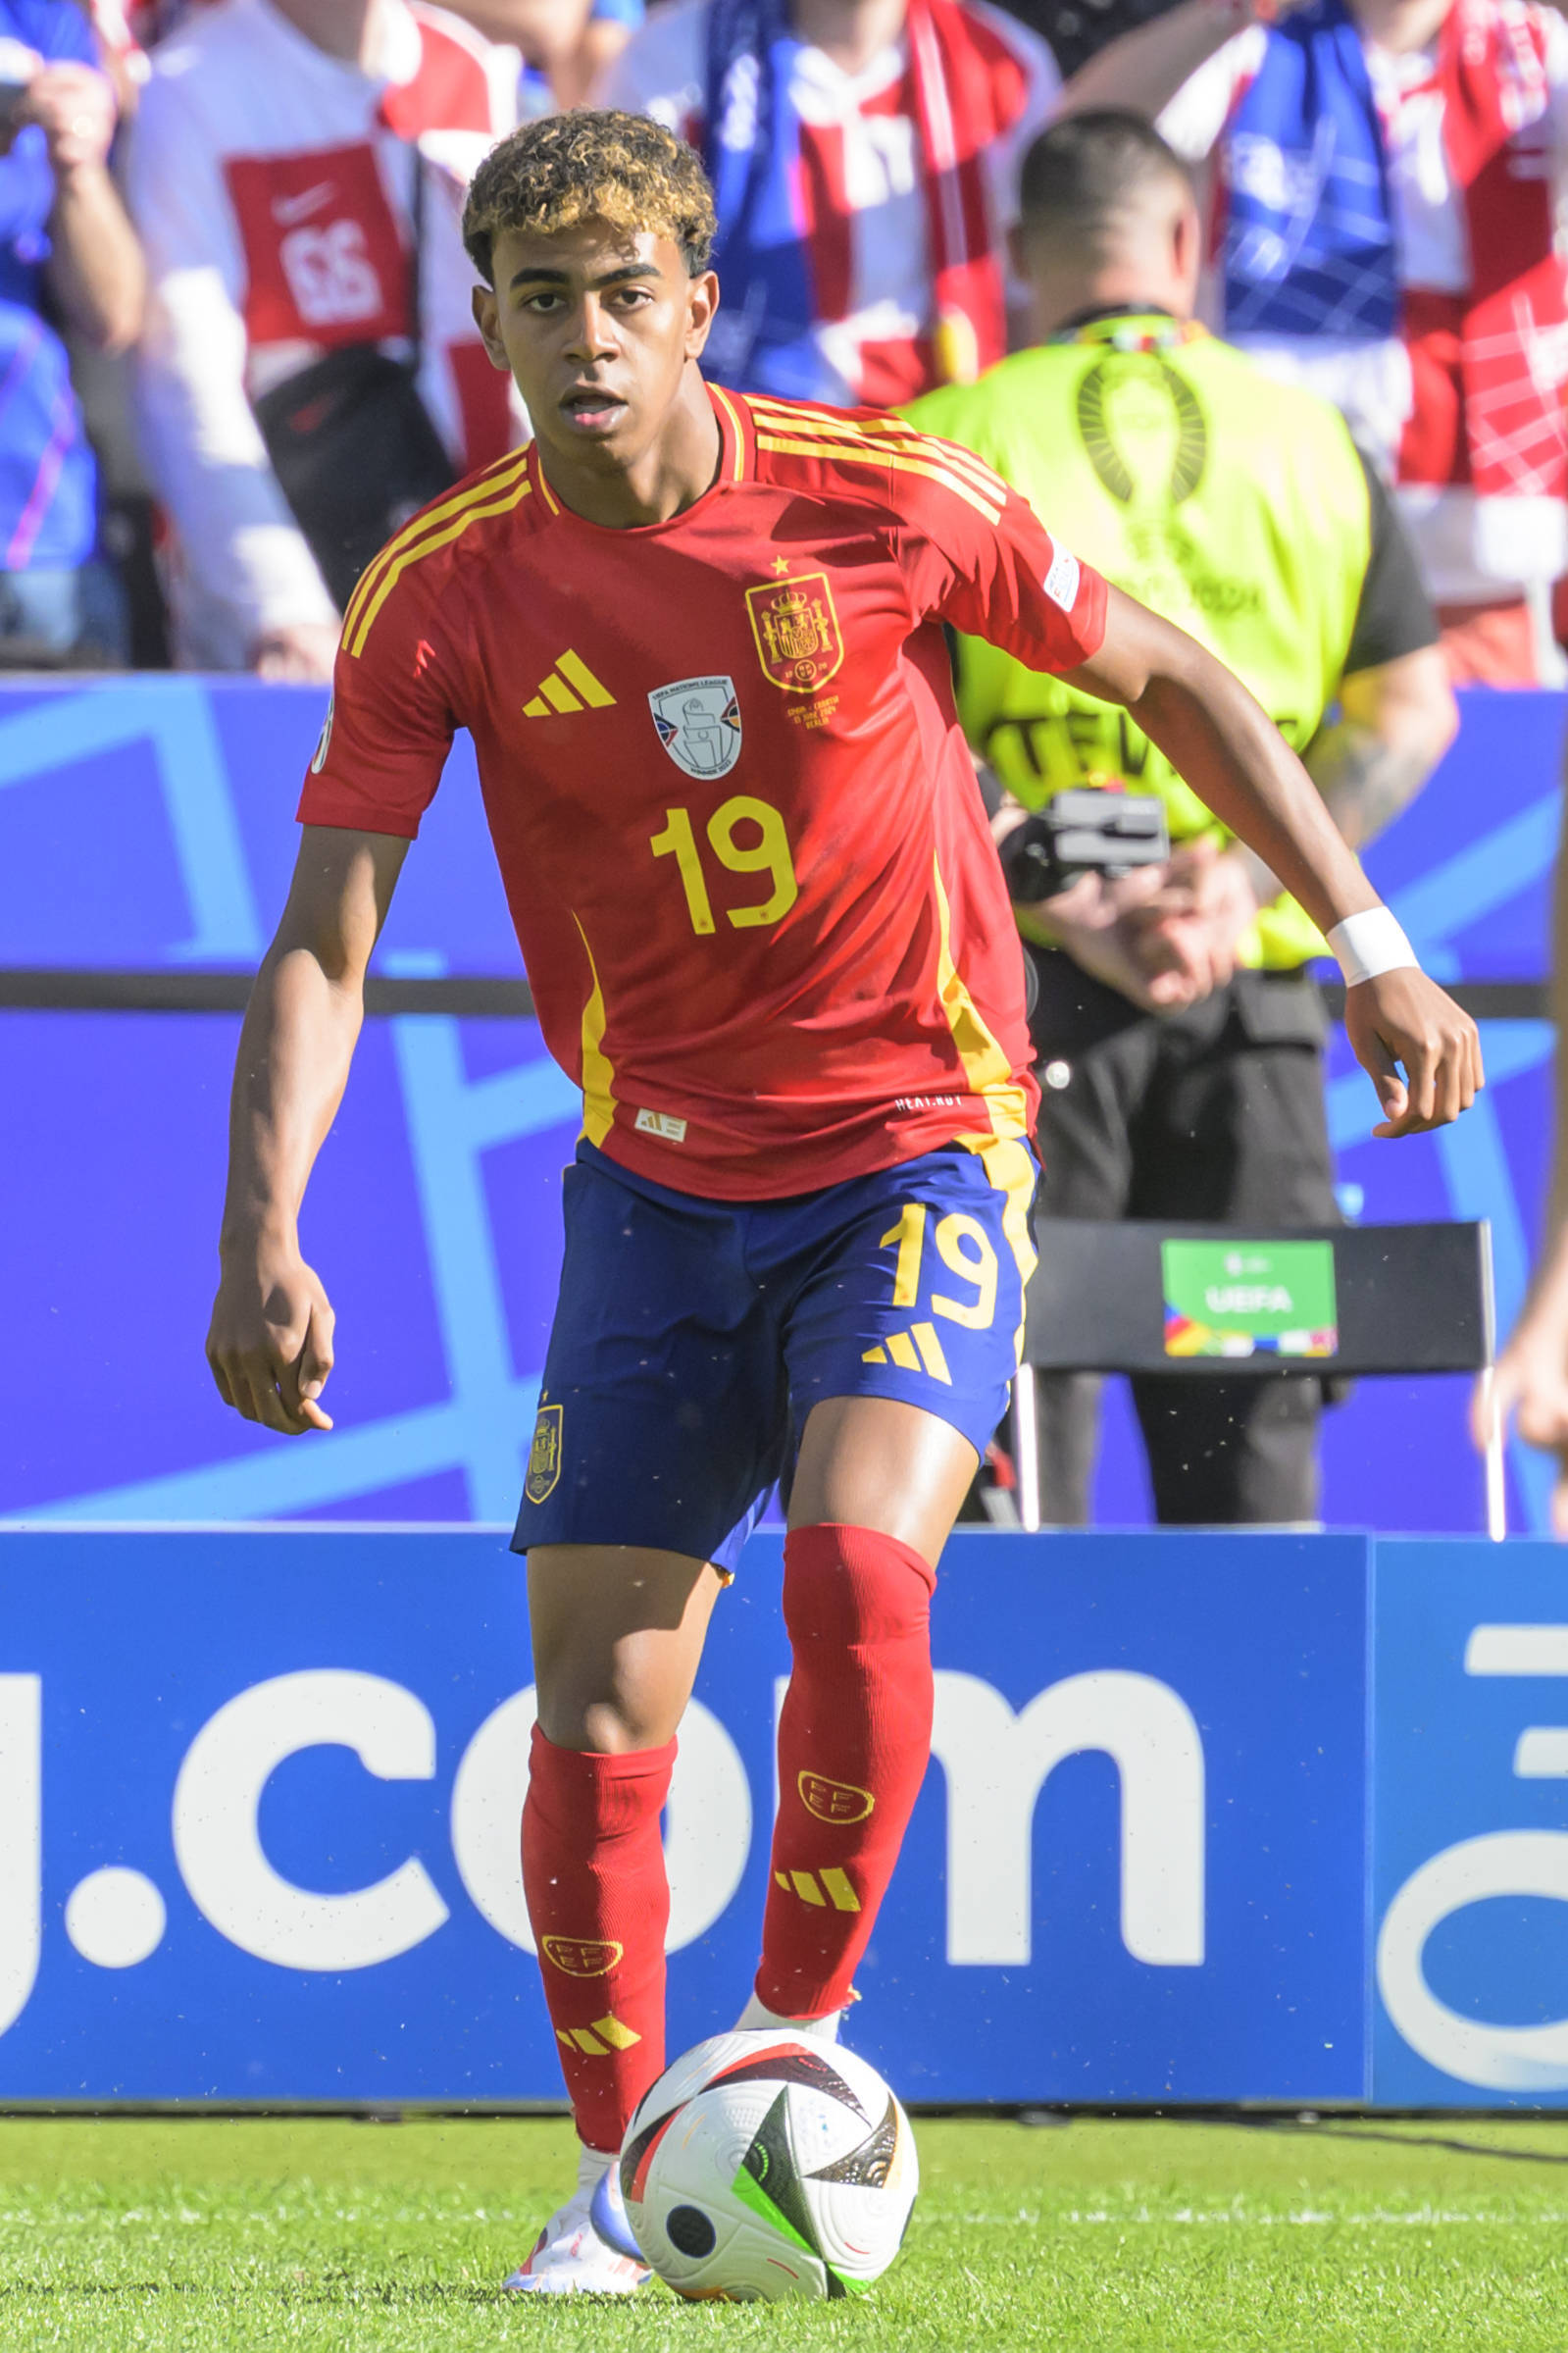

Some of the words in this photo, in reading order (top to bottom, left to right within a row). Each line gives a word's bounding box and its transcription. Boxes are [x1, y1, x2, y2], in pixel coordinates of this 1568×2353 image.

[649, 794, 799, 936] 19
[879, 1202, 999, 1331] 19
[1204, 1284, 1293, 1313] UEFA
